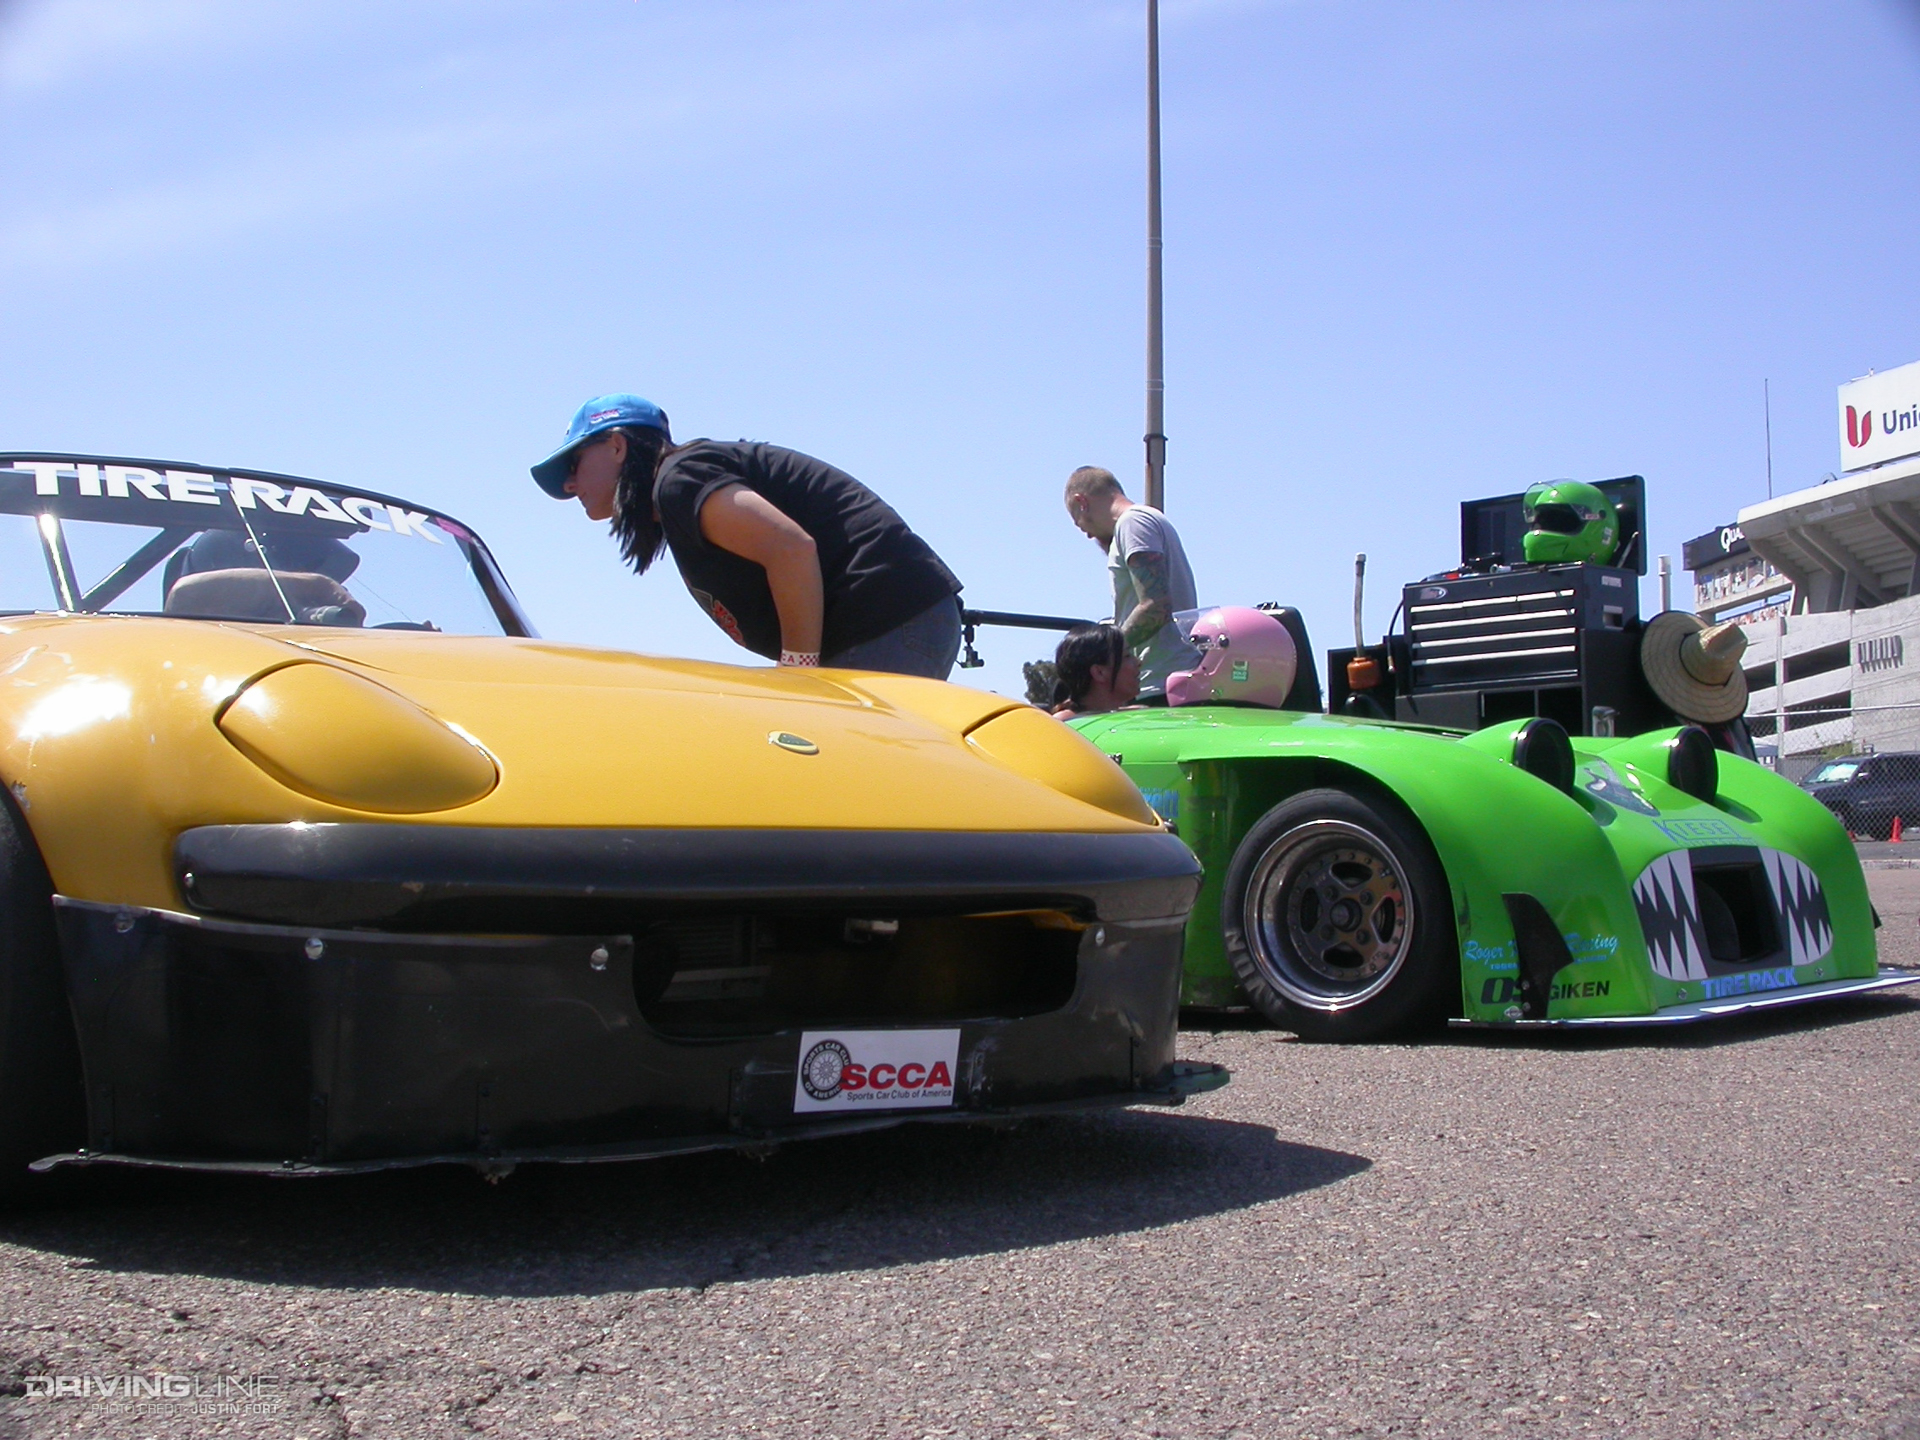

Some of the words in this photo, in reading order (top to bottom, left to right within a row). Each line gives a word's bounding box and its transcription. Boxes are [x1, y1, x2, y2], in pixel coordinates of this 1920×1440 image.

[1883, 404, 1920, 434] Uni
[13, 461, 220, 505] TIRE
[230, 477, 443, 545] RACK
[1464, 941, 1503, 966] Roger
[1551, 981, 1610, 1000] GIKEN
[1701, 974, 1746, 1000] TIRE
[840, 1049, 850, 1066] CLU
[840, 1061, 952, 1090] SCCA
[813, 1086, 841, 1098] AMERIC
[847, 1092, 874, 1102] Sports
[876, 1091, 890, 1100] Car
[891, 1090, 910, 1099] Club
[911, 1089, 920, 1098] of
[921, 1088, 952, 1098] America
